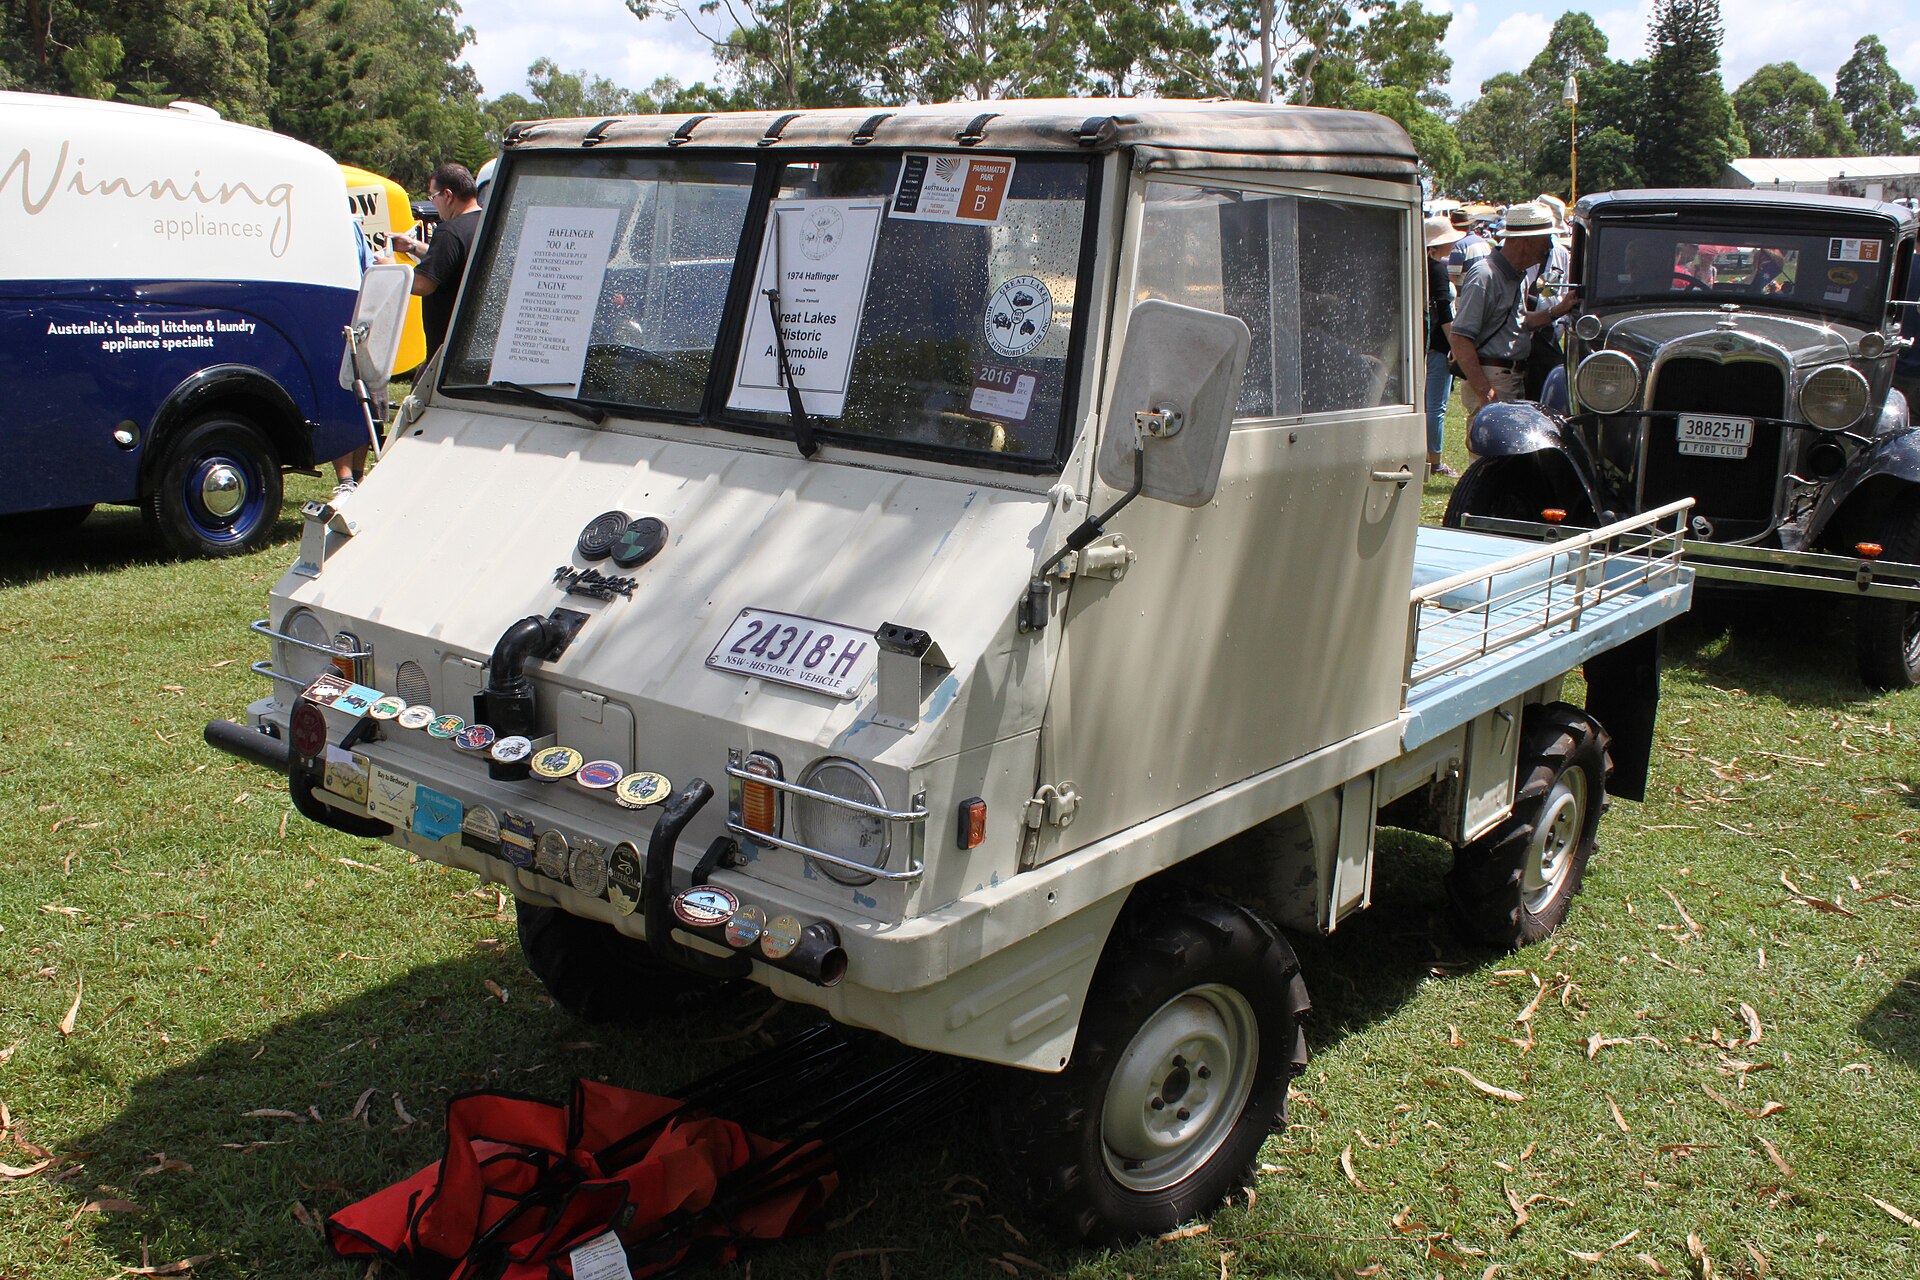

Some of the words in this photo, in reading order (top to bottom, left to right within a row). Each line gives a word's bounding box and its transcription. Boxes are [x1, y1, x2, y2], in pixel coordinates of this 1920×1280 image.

[972, 164, 1006, 174] PARRAMATTA
[980, 173, 995, 182] PARK
[924, 185, 950, 193] AUSTRALIA
[974, 194, 987, 212] B
[153, 212, 263, 241] appliances
[548, 228, 595, 239] HAFLINGER
[546, 240, 562, 250] 700
[787, 271, 803, 280] 1974
[805, 272, 839, 282] Haflinger
[536, 280, 568, 291] ENGINE
[999, 278, 1027, 295] GREAT
[1030, 279, 1050, 303] LAKES
[779, 312, 802, 323] reat
[804, 312, 837, 325] Lakes
[47, 321, 113, 335] Australia's
[115, 320, 160, 336] leading
[162, 320, 203, 333] kitchen
[205, 319, 215, 333] &
[217, 319, 256, 334] laundry
[985, 305, 994, 341] HISTORIC
[990, 340, 1026, 356] AUTOMOBILE
[1027, 334, 1042, 350] CLUB
[780, 328, 822, 342] Historic
[102, 336, 159, 352] appliance
[162, 335, 214, 351] specialist
[979, 367, 1012, 385] 2016
[1682, 444, 1688, 452] A
[1693, 444, 1716, 454] FORD
[1720, 446, 1743, 456] CLUB
[799, 671, 843, 688] VEHICLE
[377, 770, 386, 778] Bay
[389, 774, 410, 789] Birdwood
